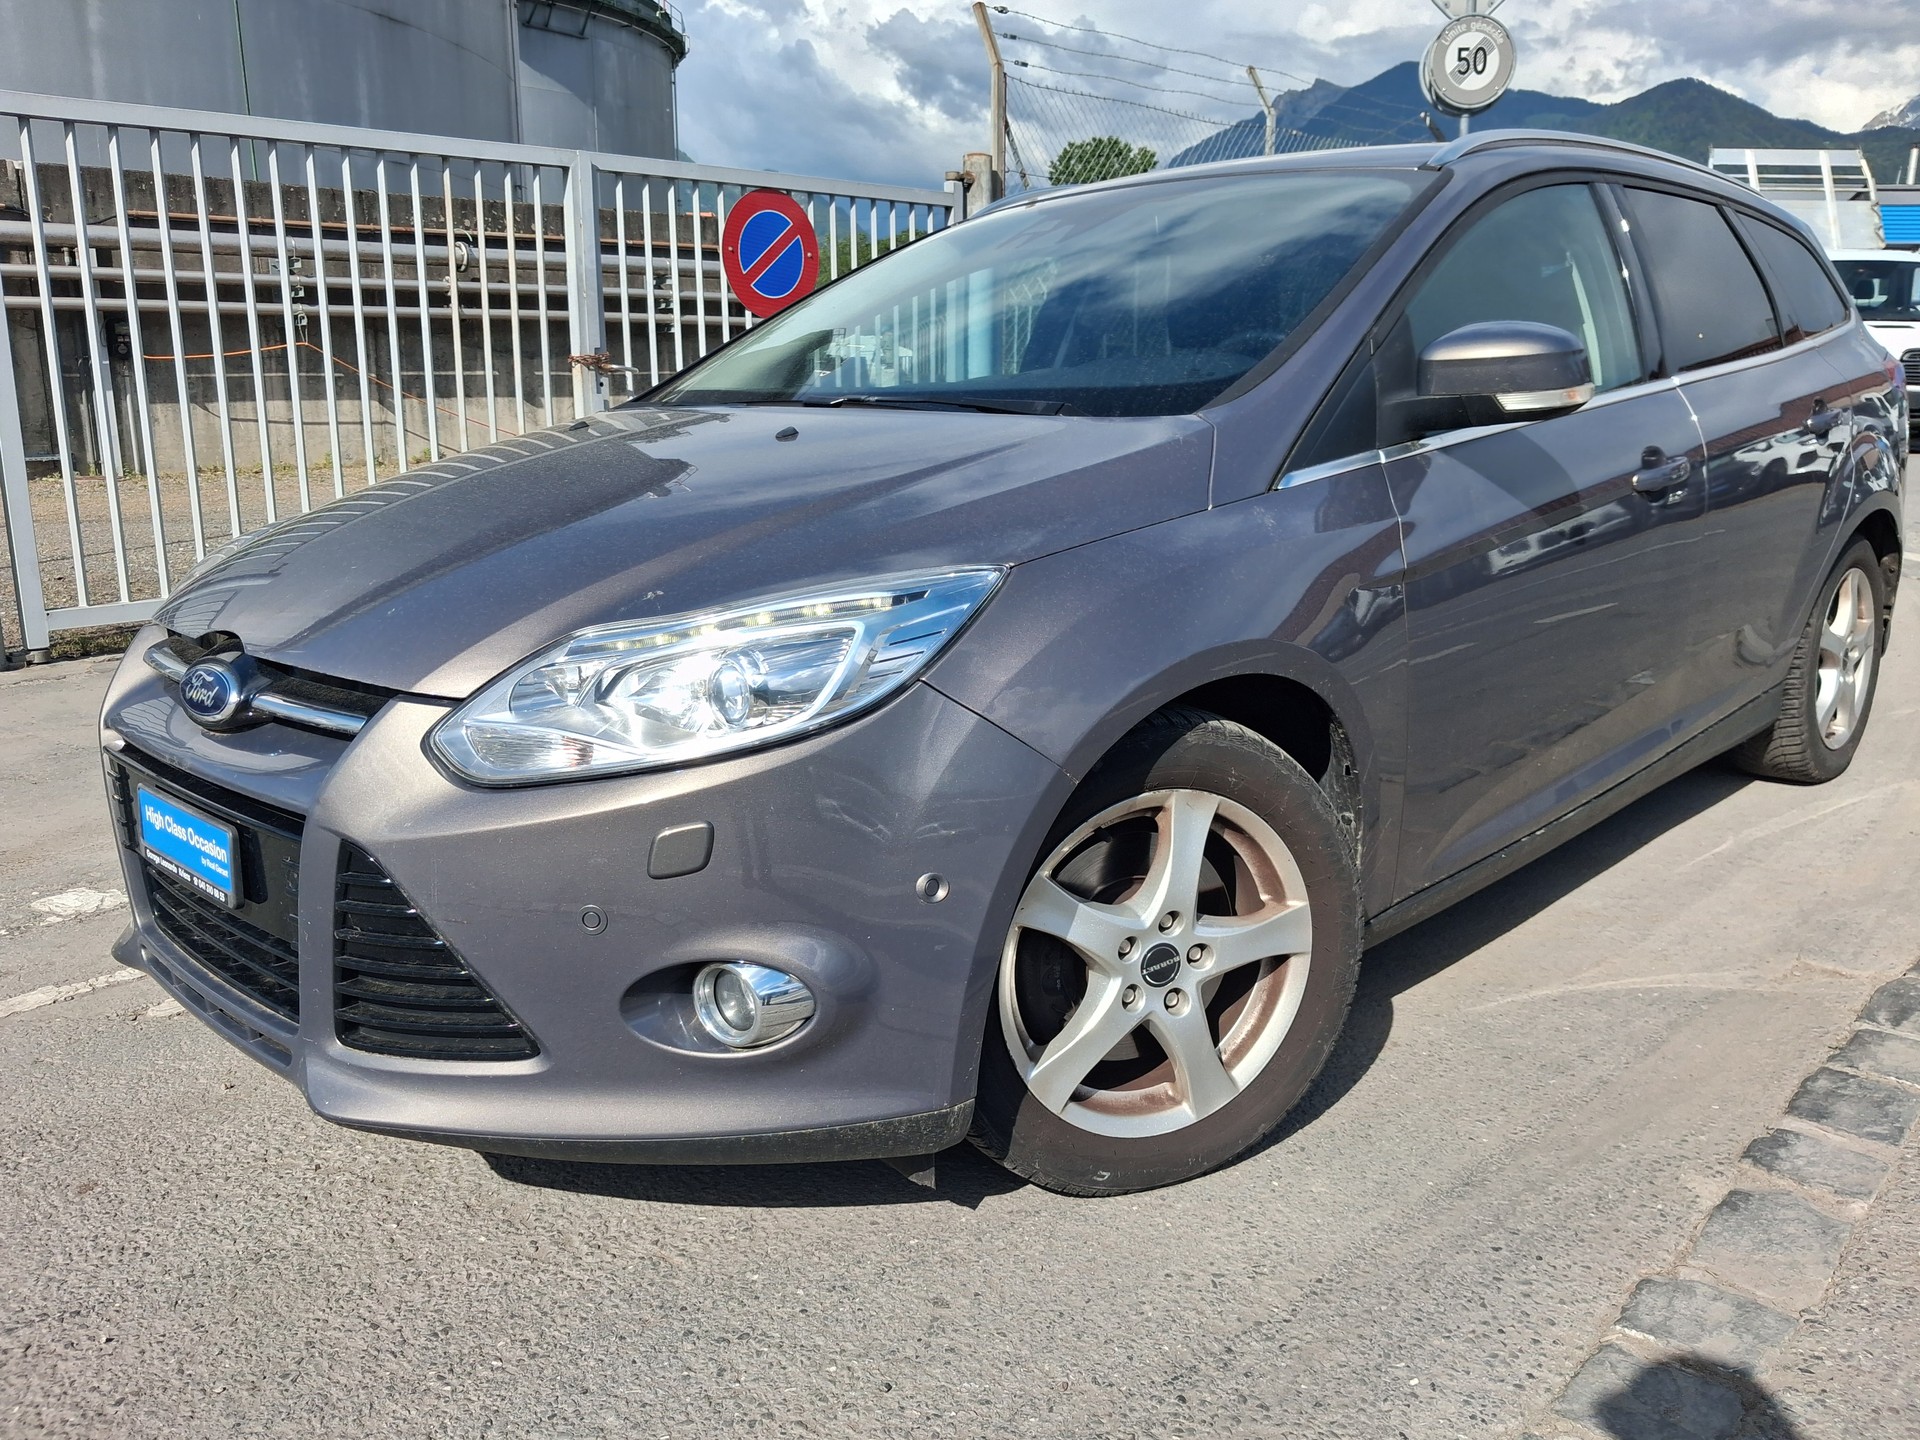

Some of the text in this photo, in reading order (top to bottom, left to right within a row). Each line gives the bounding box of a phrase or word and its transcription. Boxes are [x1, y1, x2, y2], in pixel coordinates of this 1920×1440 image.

[1441, 20, 1504, 46] Limite générale
[1457, 46, 1487, 75] 50
[185, 671, 219, 708] Ford
[145, 804, 228, 864] High Class Occasion
